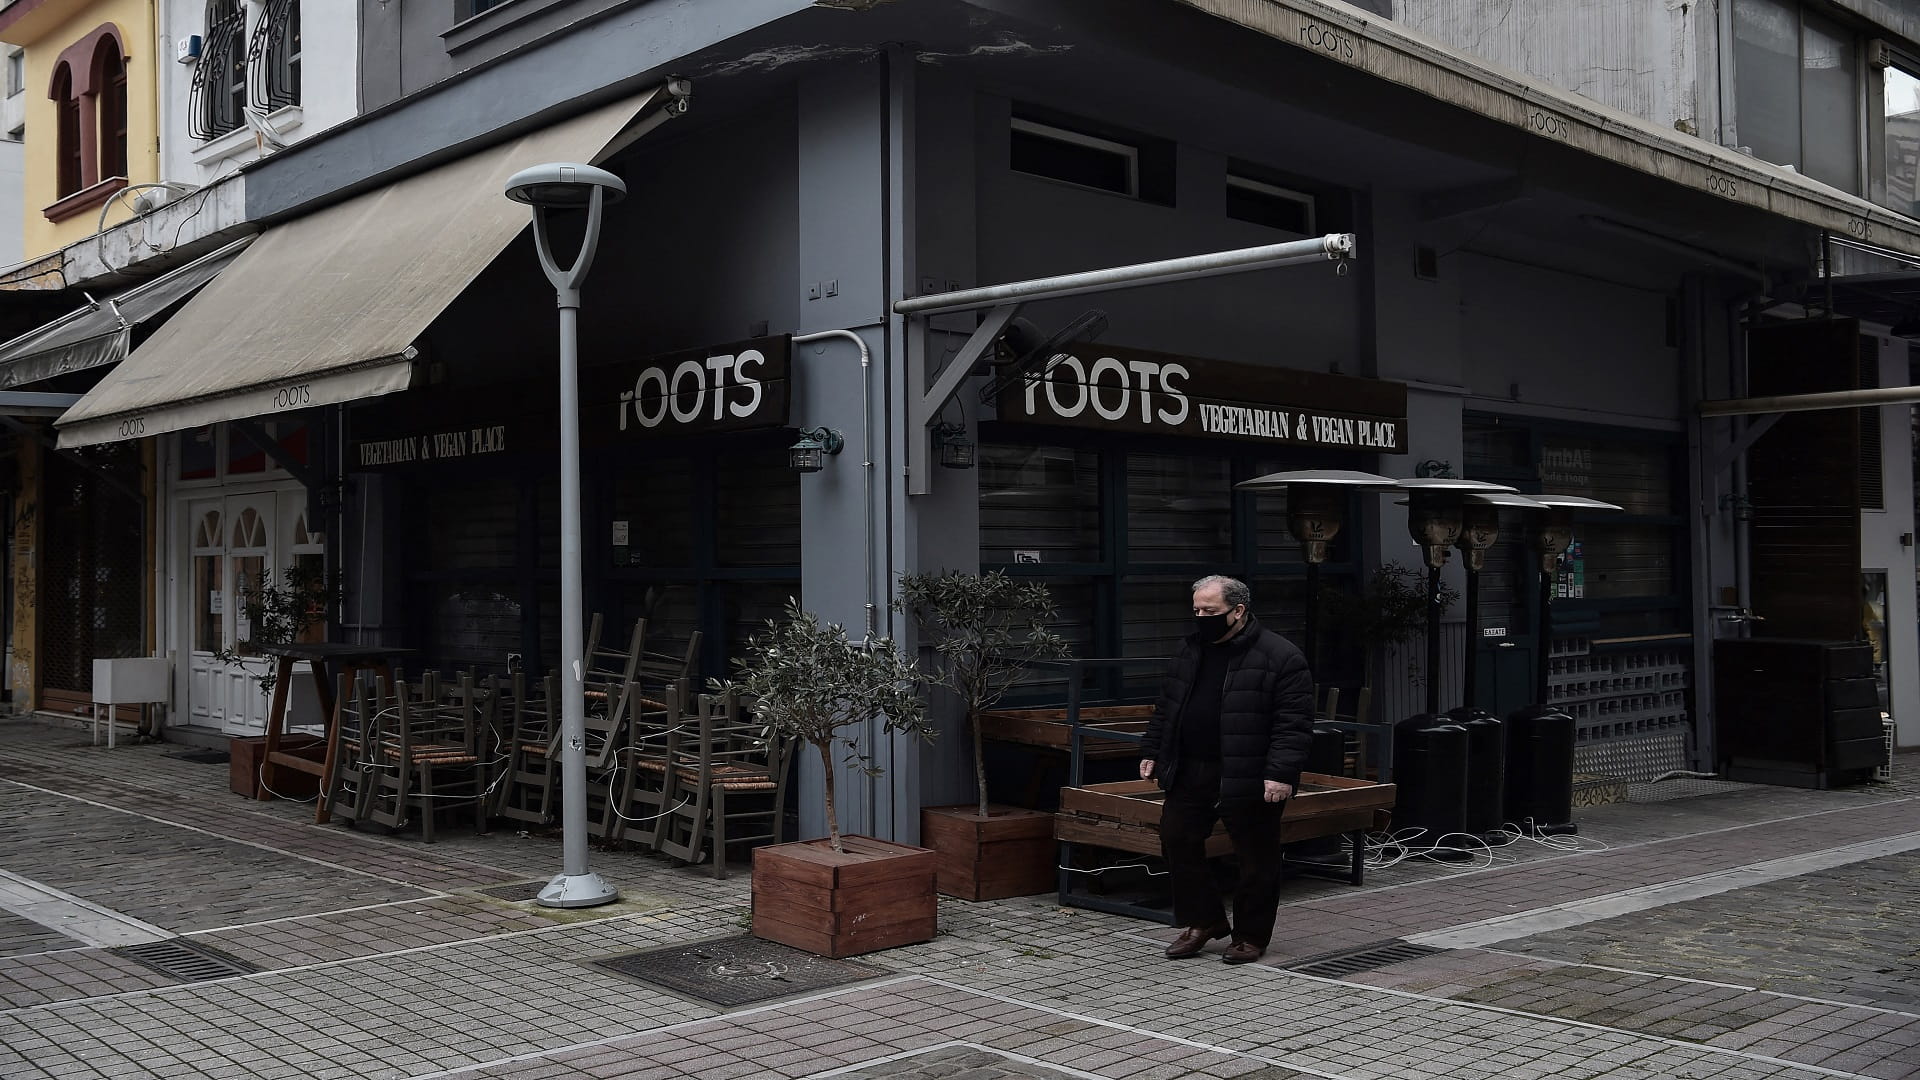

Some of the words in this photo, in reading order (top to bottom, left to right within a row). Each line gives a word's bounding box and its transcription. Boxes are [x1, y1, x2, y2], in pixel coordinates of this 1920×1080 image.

[1300, 24, 1353, 59] rOOTS
[1530, 112, 1567, 139] rOOTS
[273, 384, 311, 409] rOOTS
[619, 349, 765, 431] rOOTS
[1024, 353, 1190, 426] rOOTS
[118, 417, 145, 437] rOOTS
[1199, 403, 1290, 439] VEGETARIAN
[1296, 413, 1308, 441] &
[1312, 415, 1354, 445] VEGAN
[1357, 420, 1396, 449] PLACE
[359, 436, 417, 466] VEGETARIAN
[421, 435, 430, 460] &
[433, 431, 467, 458] VEGAN
[471, 425, 505, 454] PLACE
